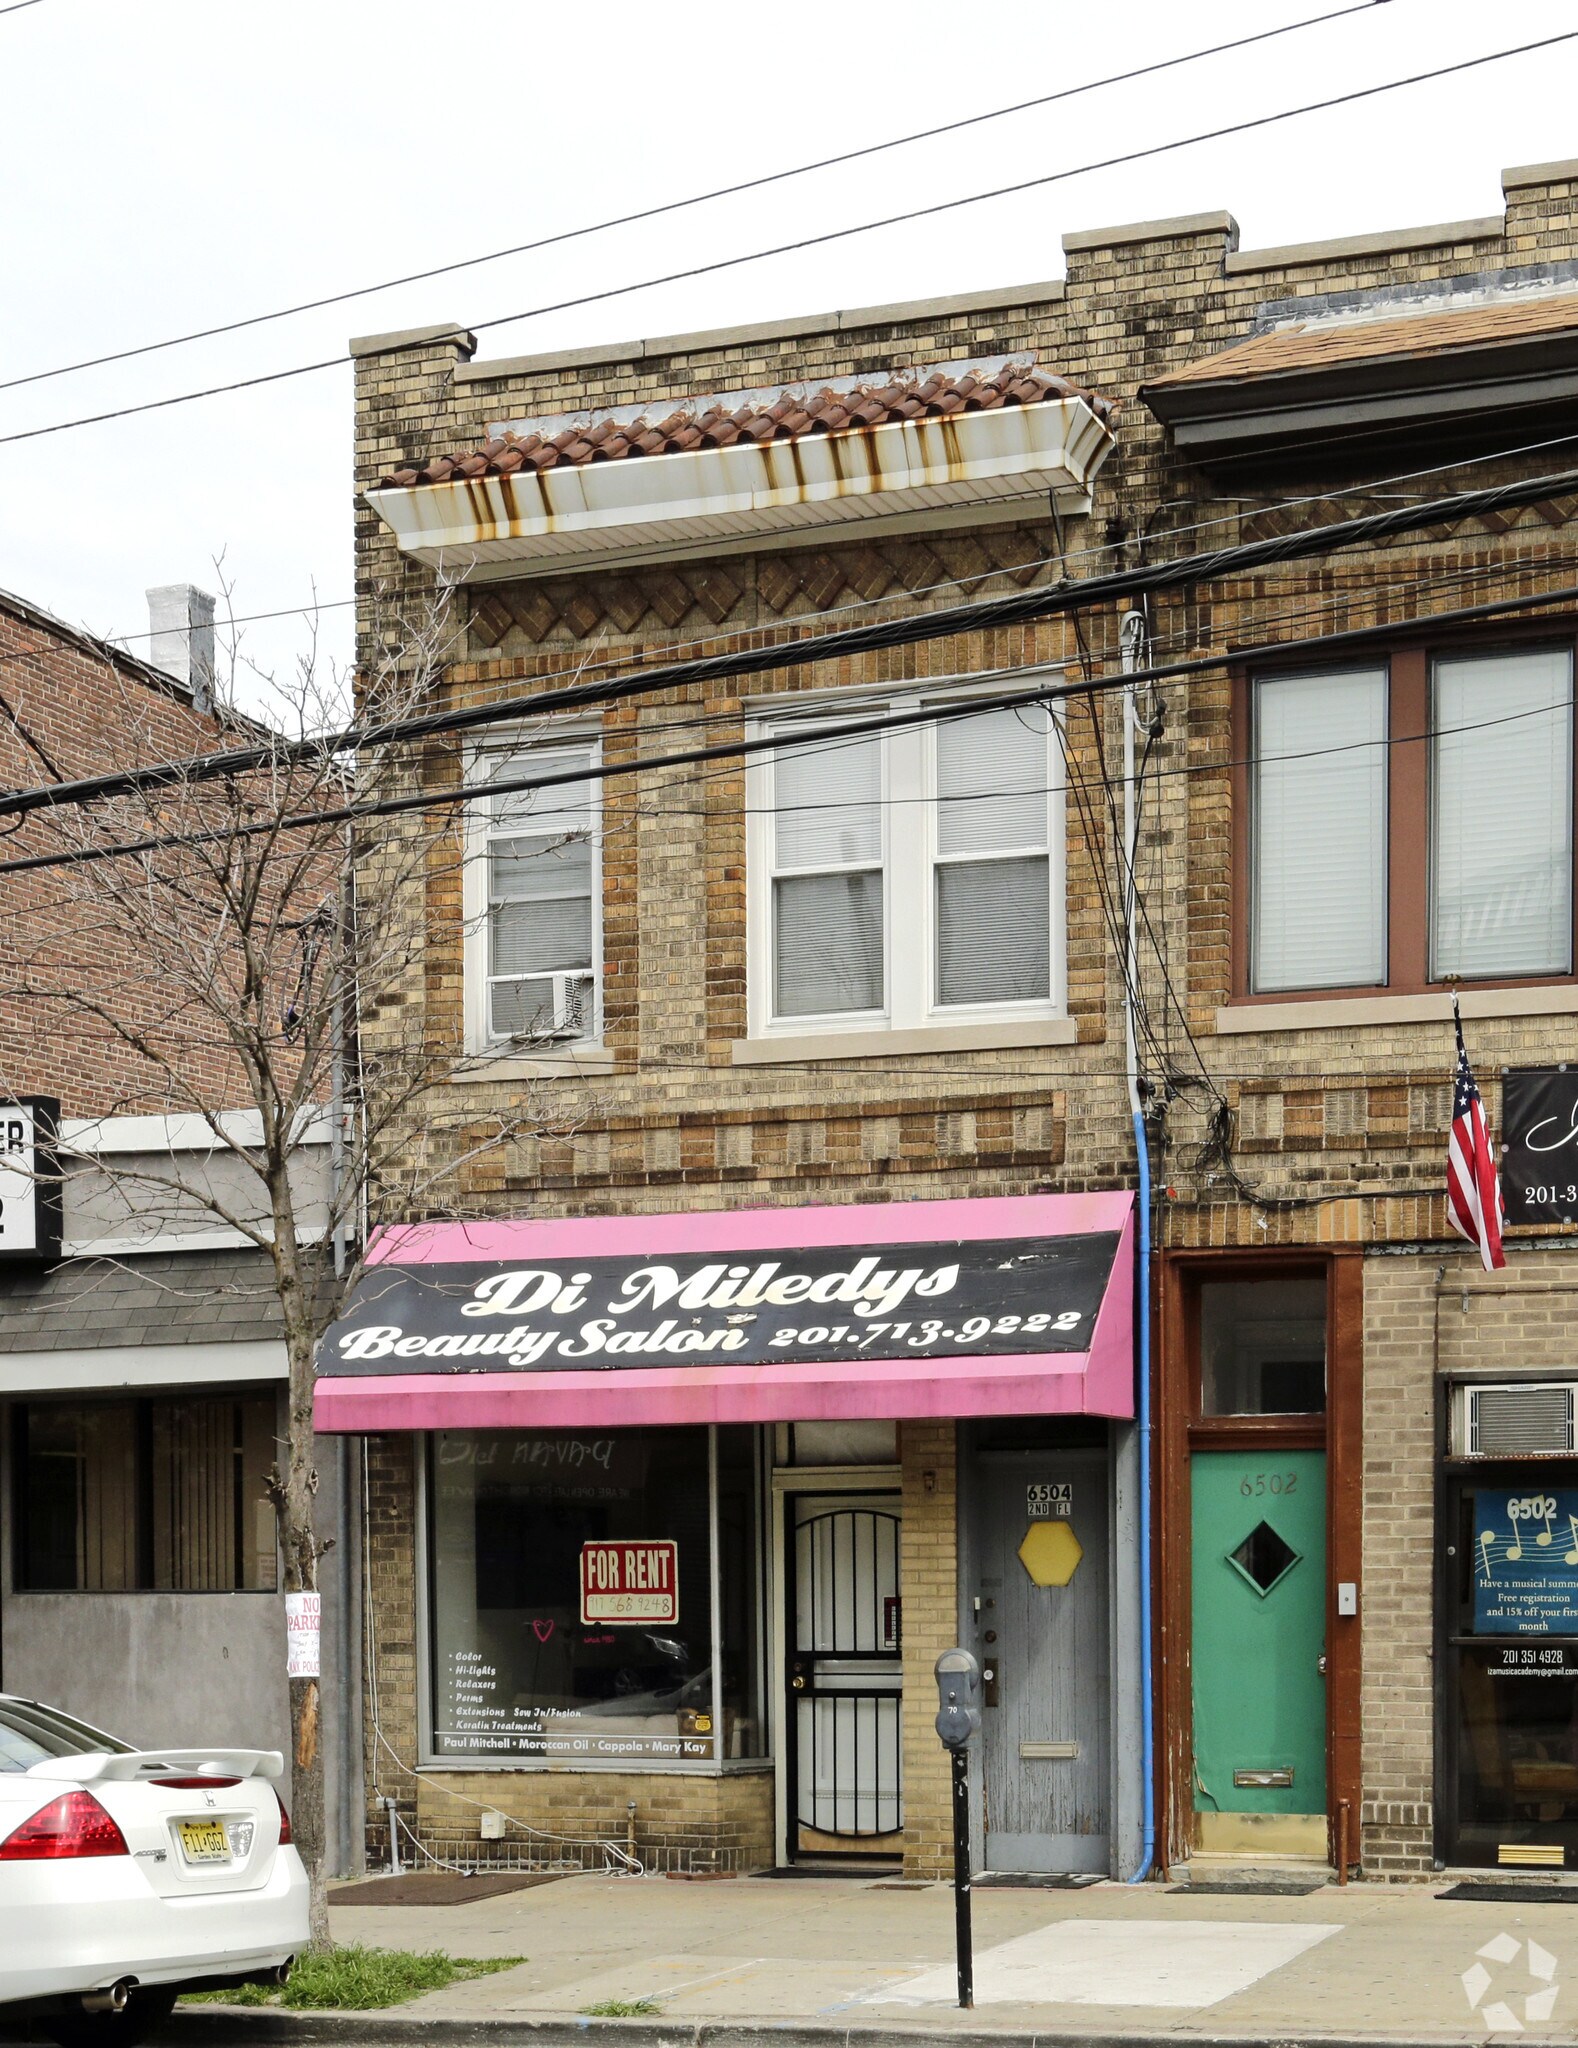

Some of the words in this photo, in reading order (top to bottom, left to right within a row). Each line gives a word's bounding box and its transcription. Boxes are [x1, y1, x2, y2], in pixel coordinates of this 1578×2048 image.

[1525, 1185, 1578, 1204] 201-3
[461, 1270, 593, 1317] Di
[607, 1257, 960, 1318] Miledys
[339, 1325, 560, 1366] Beauty
[557, 1319, 749, 1357] Salon
[1240, 1472, 1298, 1496] 6502
[1028, 1485, 1071, 1500] 6504
[1029, 1503, 1048, 1514] 2ND
[1507, 1498, 1557, 1519] 6502
[587, 1549, 619, 1589] FOR
[625, 1549, 670, 1589] RENT
[1479, 1578, 1502, 1588] Have
[1512, 1578, 1546, 1588] musical
[303, 1597, 320, 1613] NO
[638, 1597, 670, 1613] 9248
[1498, 1593, 1518, 1603] Free
[1519, 1593, 1570, 1605] registration
[1486, 1607, 1504, 1616] and
[1506, 1607, 1522, 1616] 15%
[1524, 1607, 1539, 1616] off
[1540, 1609, 1561, 1619] your
[1518, 1620, 1549, 1631] month
[455, 1652, 482, 1661] Color
[1503, 1650, 1518, 1664] 201
[1521, 1650, 1536, 1664] 351
[1538, 1650, 1563, 1664] 4928
[455, 1680, 496, 1689] Relaxers
[455, 1693, 483, 1703] Perms
[456, 1707, 505, 1717] Extensions
[513, 1708, 531, 1717] Sew
[948, 1706, 958, 1714] 70
[456, 1720, 489, 1730] Keratin
[492, 1721, 542, 1731] Treatments
[444, 1737, 467, 1748] Paul
[469, 1738, 510, 1748] Mitchell
[518, 1739, 570, 1750] Moroccan
[573, 1740, 589, 1750] Oil
[598, 1741, 643, 1753] Cappola
[652, 1742, 681, 1754] Mary
[684, 1742, 706, 1754] Kay
